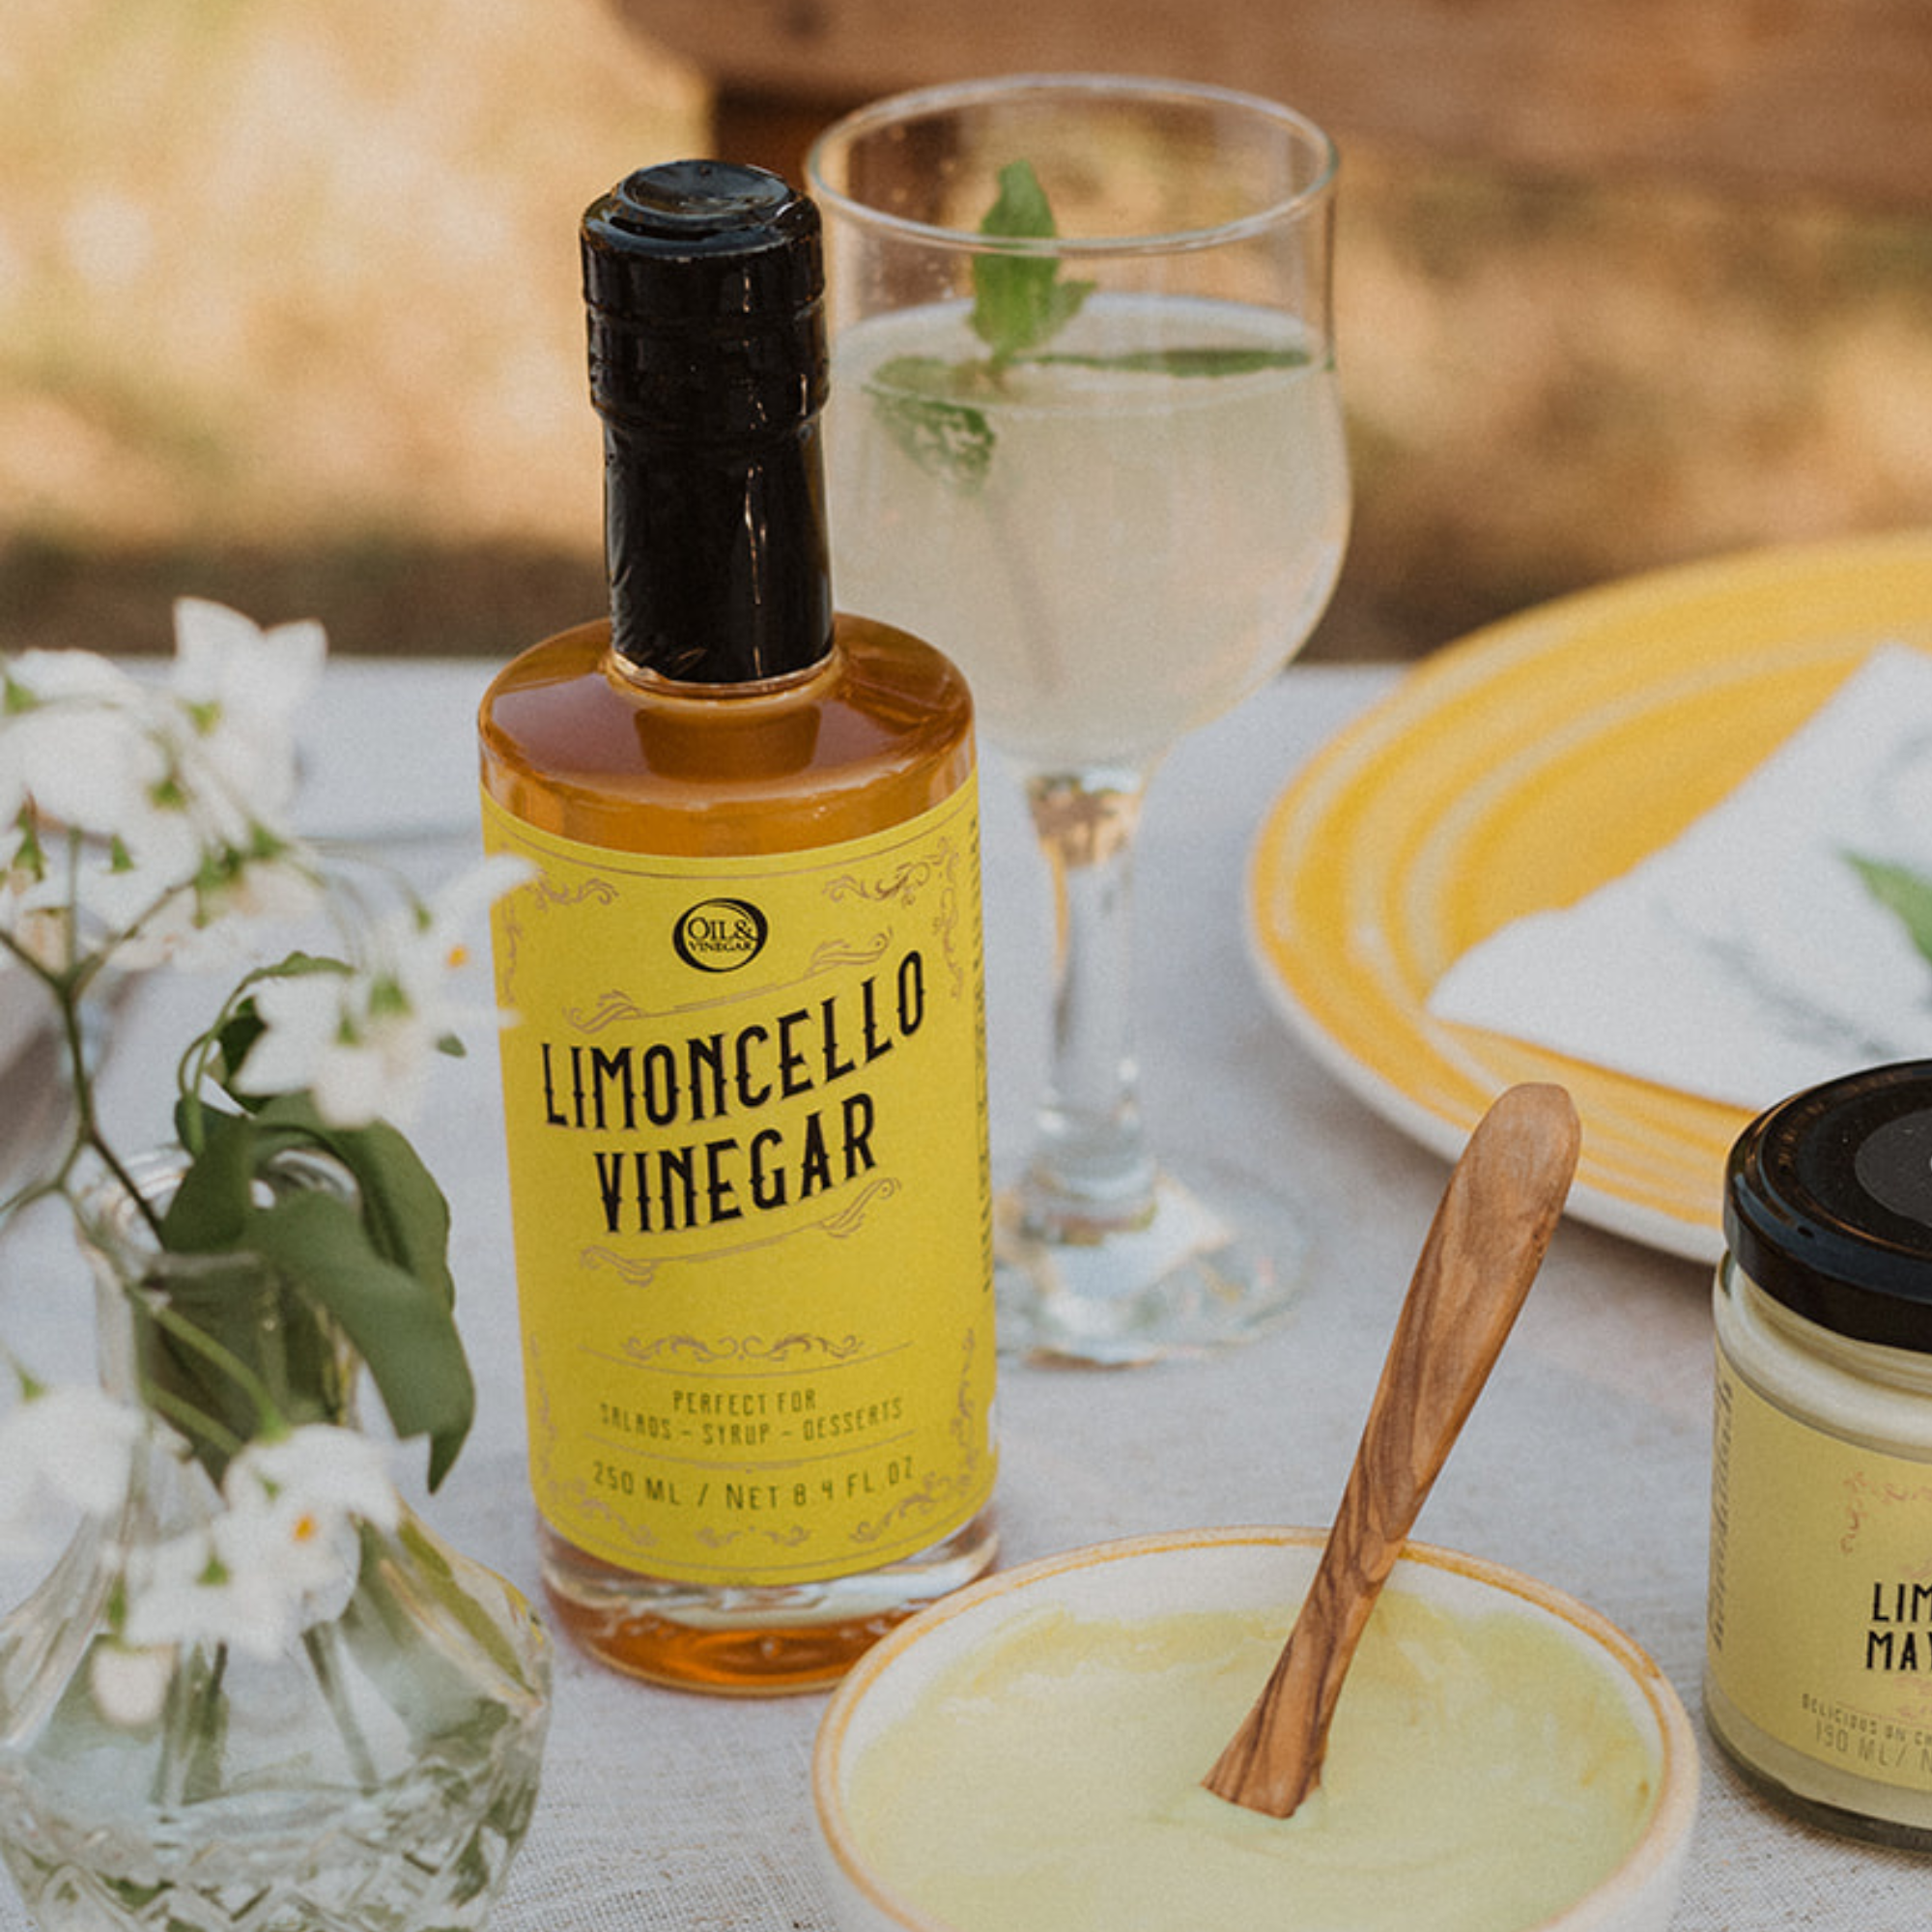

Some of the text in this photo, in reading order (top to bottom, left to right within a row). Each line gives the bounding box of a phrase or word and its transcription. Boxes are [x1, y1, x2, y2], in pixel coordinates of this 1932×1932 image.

[688, 940, 752, 952] VINEGAR
[541, 950, 924, 1129] LIMONCELLO
[594, 1093, 877, 1234] VINEGAR
[600, 1402, 671, 1440] SALADS
[702, 1422, 770, 1445] SYRUP
[803, 1397, 902, 1441] DESSERTS
[673, 1389, 816, 1417] PERFECT FOR
[592, 1461, 634, 1495] 250
[645, 1477, 680, 1507] ML
[697, 1483, 709, 1508] /
[725, 1482, 779, 1510] NET
[847, 1470, 874, 1498] FL
[889, 1456, 912, 1485] OZ
[1865, 1631, 1932, 1671] MA
